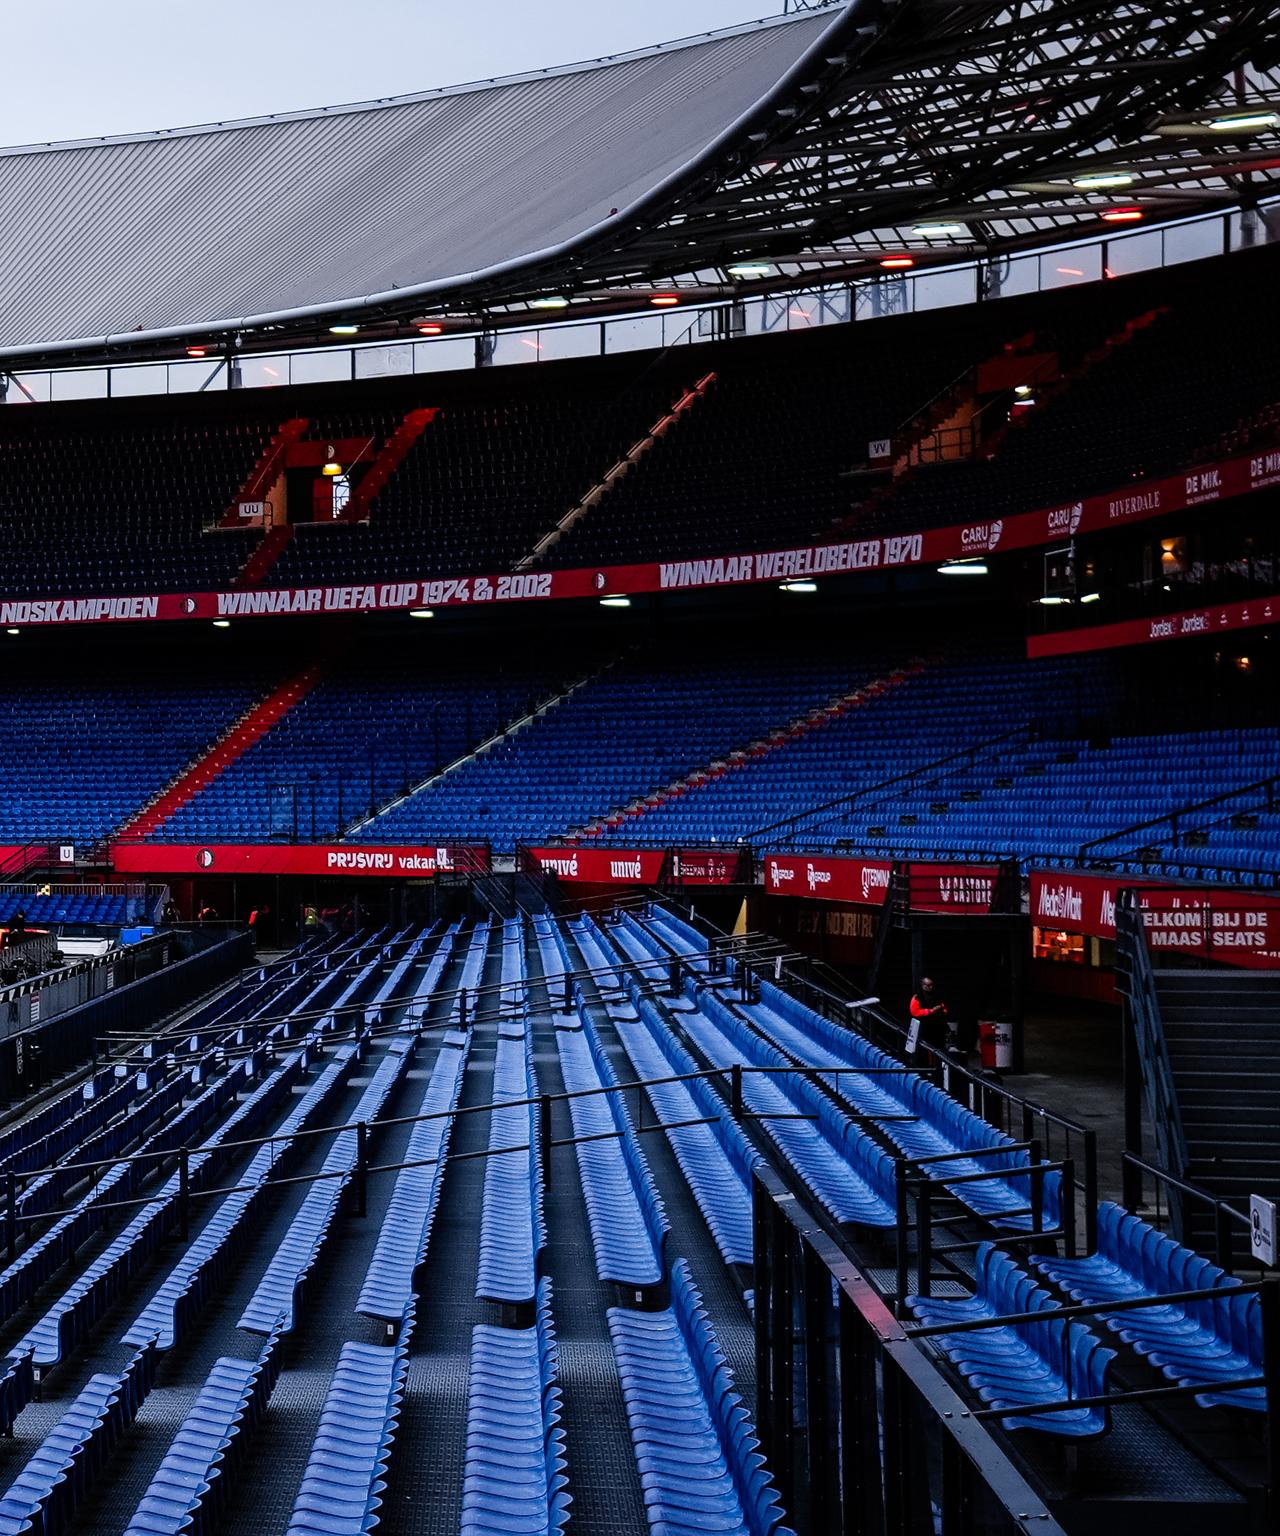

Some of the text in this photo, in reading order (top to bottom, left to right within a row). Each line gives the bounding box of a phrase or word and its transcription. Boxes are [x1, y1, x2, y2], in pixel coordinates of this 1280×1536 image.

[1251, 457, 1263, 477] DE
[1186, 475, 1198, 494] DE
[1109, 490, 1160, 518] RIVERDALE
[1048, 508, 1070, 528] CARU
[961, 525, 988, 544] CARU
[660, 534, 923, 588] WINNAAR WERELDBEKER 1970
[217, 573, 553, 615] WINNAAR UEFA CUP 1974 & 2002
[610, 855, 642, 879] univé
[1141, 912, 1268, 927] ELKOM BIJ DE
[1151, 931, 1266, 946] MAAS SEATS
